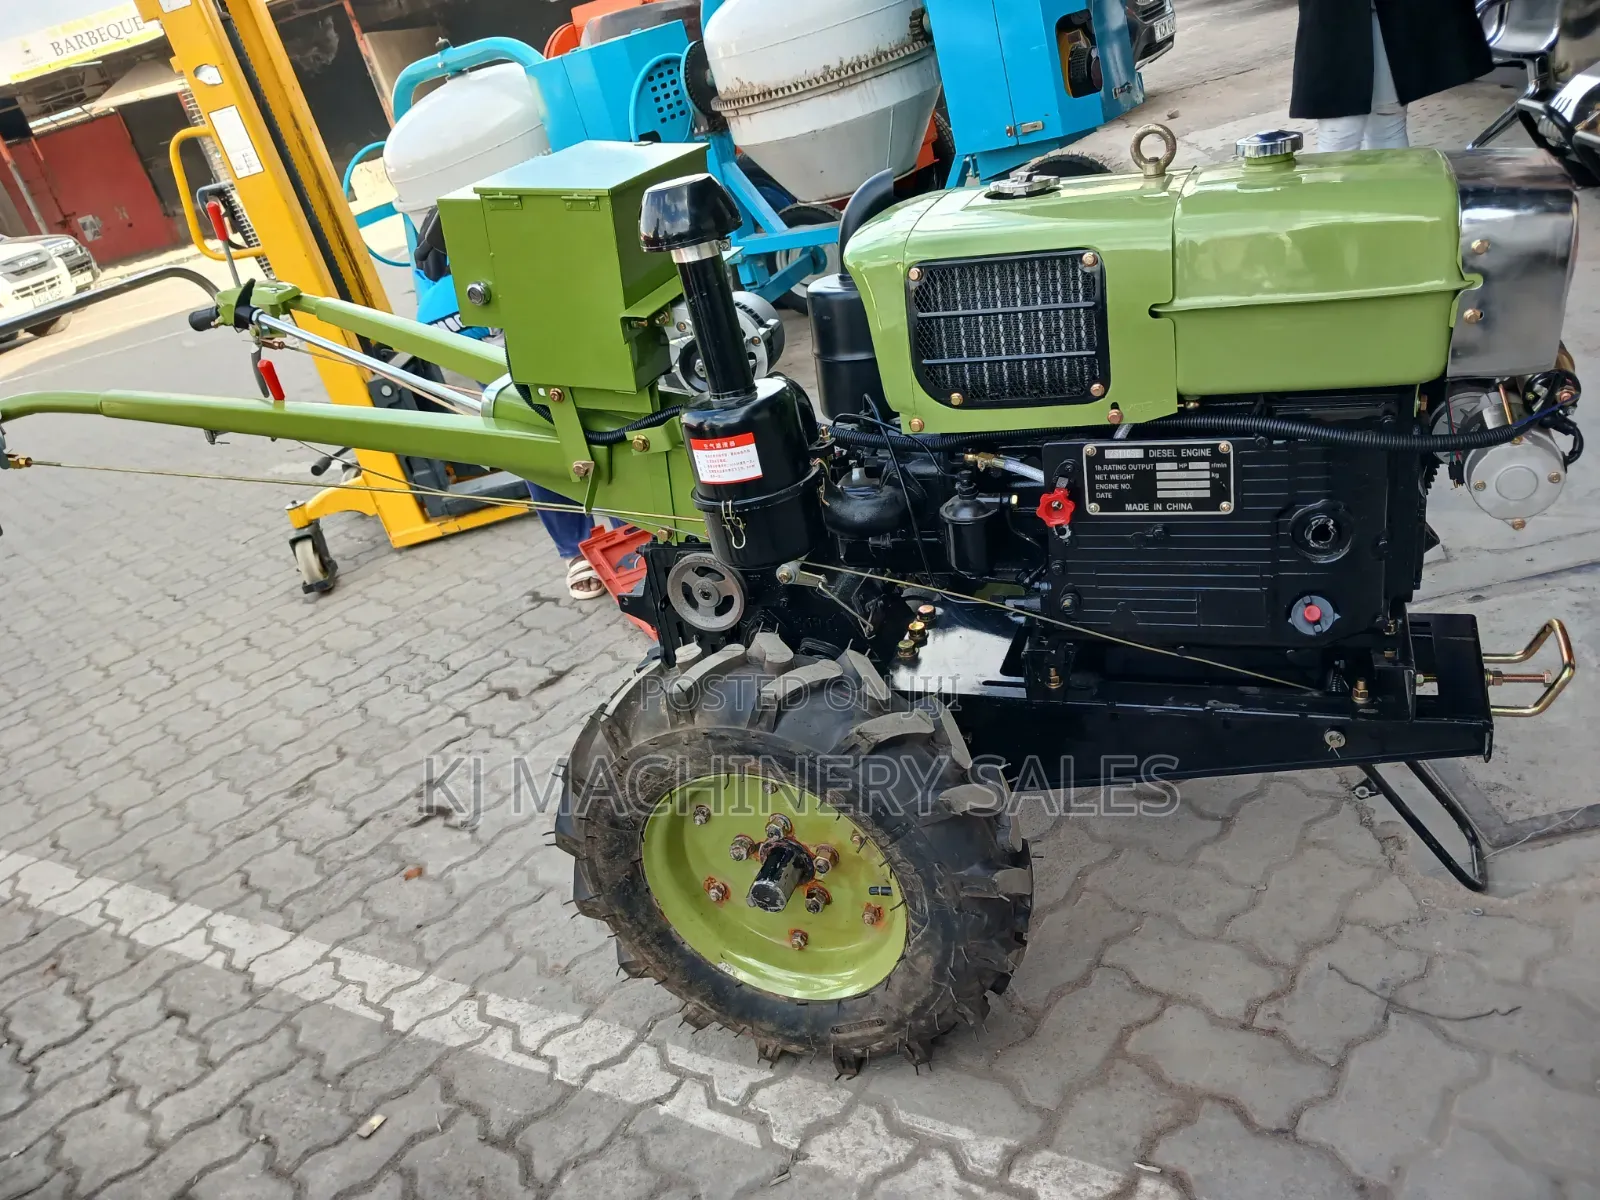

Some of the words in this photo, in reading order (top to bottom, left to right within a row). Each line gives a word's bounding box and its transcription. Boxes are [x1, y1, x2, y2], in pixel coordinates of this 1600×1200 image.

[50, 16, 145, 57] BARBEQUE
[1148, 449, 1177, 458] DIESEL
[1181, 448, 1212, 457] ENGINE
[1128, 463, 1154, 471] OUTPUT
[1125, 502, 1150, 511] MADE
[1153, 502, 1162, 511] IN
[1166, 502, 1193, 511] CHINA
